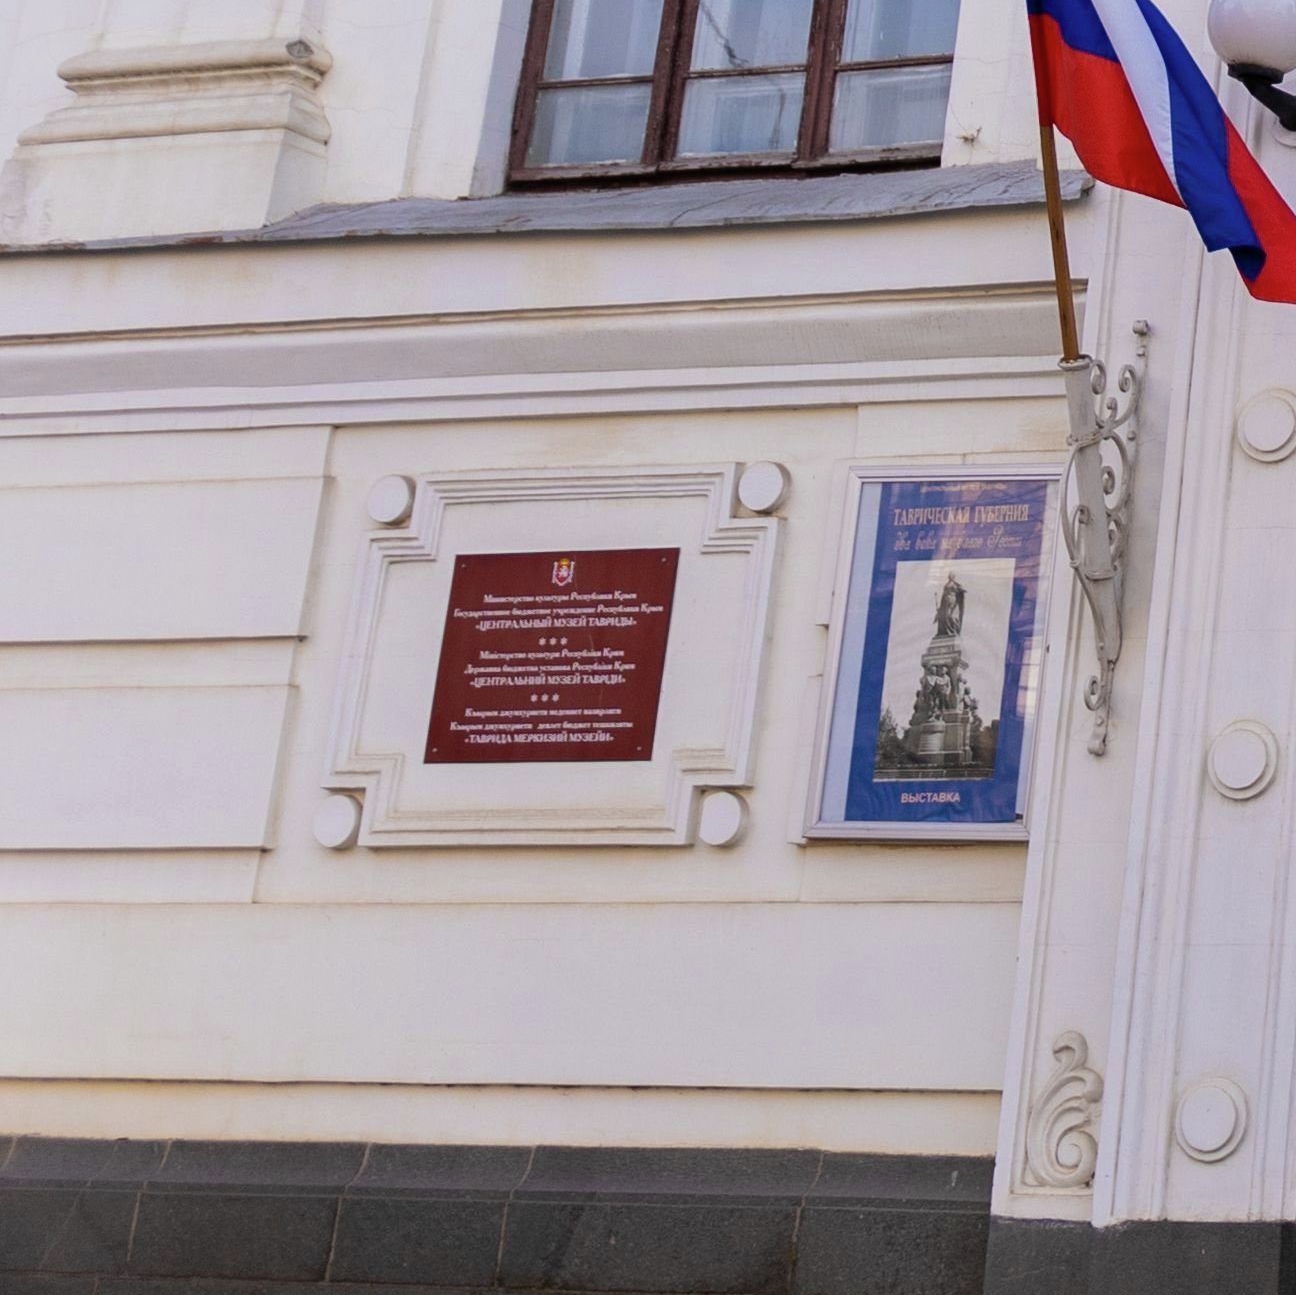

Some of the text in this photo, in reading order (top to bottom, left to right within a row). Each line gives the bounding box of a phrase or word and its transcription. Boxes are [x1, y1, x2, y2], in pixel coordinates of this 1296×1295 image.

[894, 504, 1029, 525] ТАВРИЧЕСКАЯ ГУБЕРНИЯ
[901, 791, 961, 804] ВЫСТАВКА
